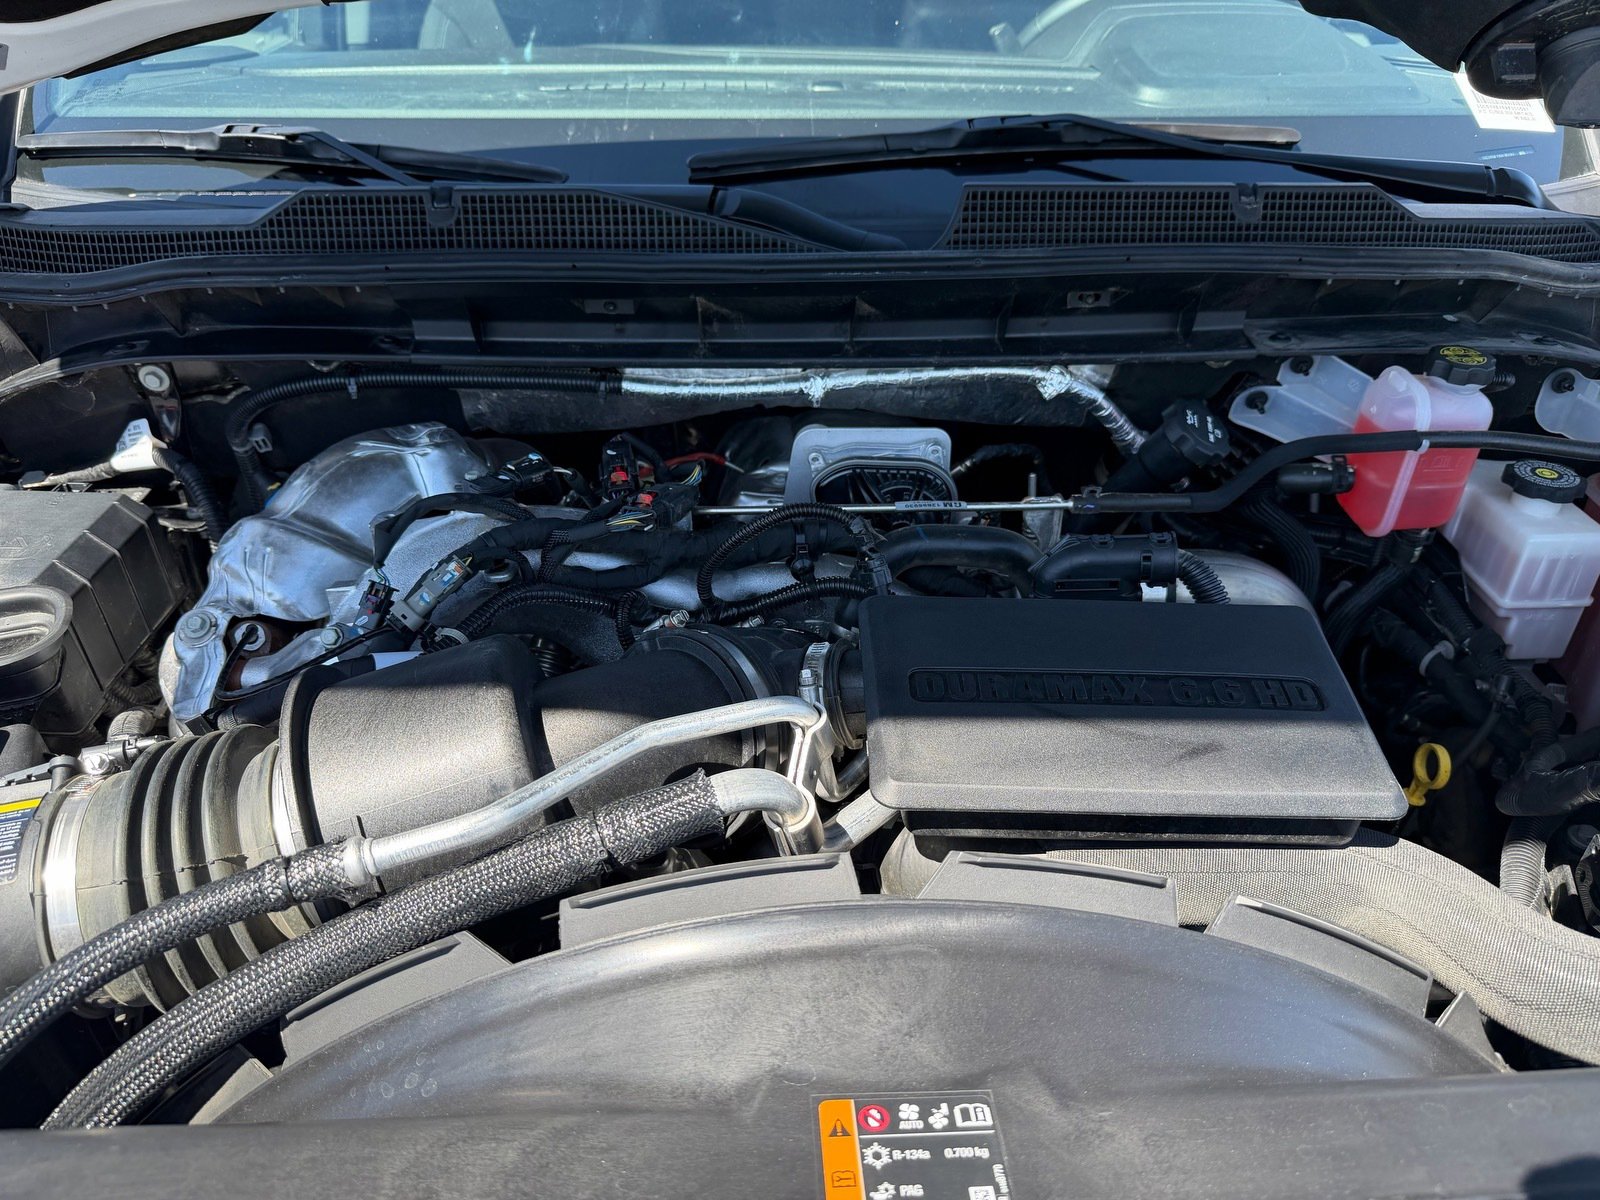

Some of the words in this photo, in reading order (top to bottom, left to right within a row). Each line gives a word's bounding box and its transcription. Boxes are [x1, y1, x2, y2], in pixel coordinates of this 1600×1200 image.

[914, 673, 1152, 704] DURAMAX
[1168, 677, 1246, 706] 6.6
[1253, 679, 1320, 707] HD
[899, 1120, 924, 1130] AUTO
[892, 1148, 931, 1160] R-134a
[974, 1146, 990, 1159] kg
[899, 1184, 924, 1197] PAG
